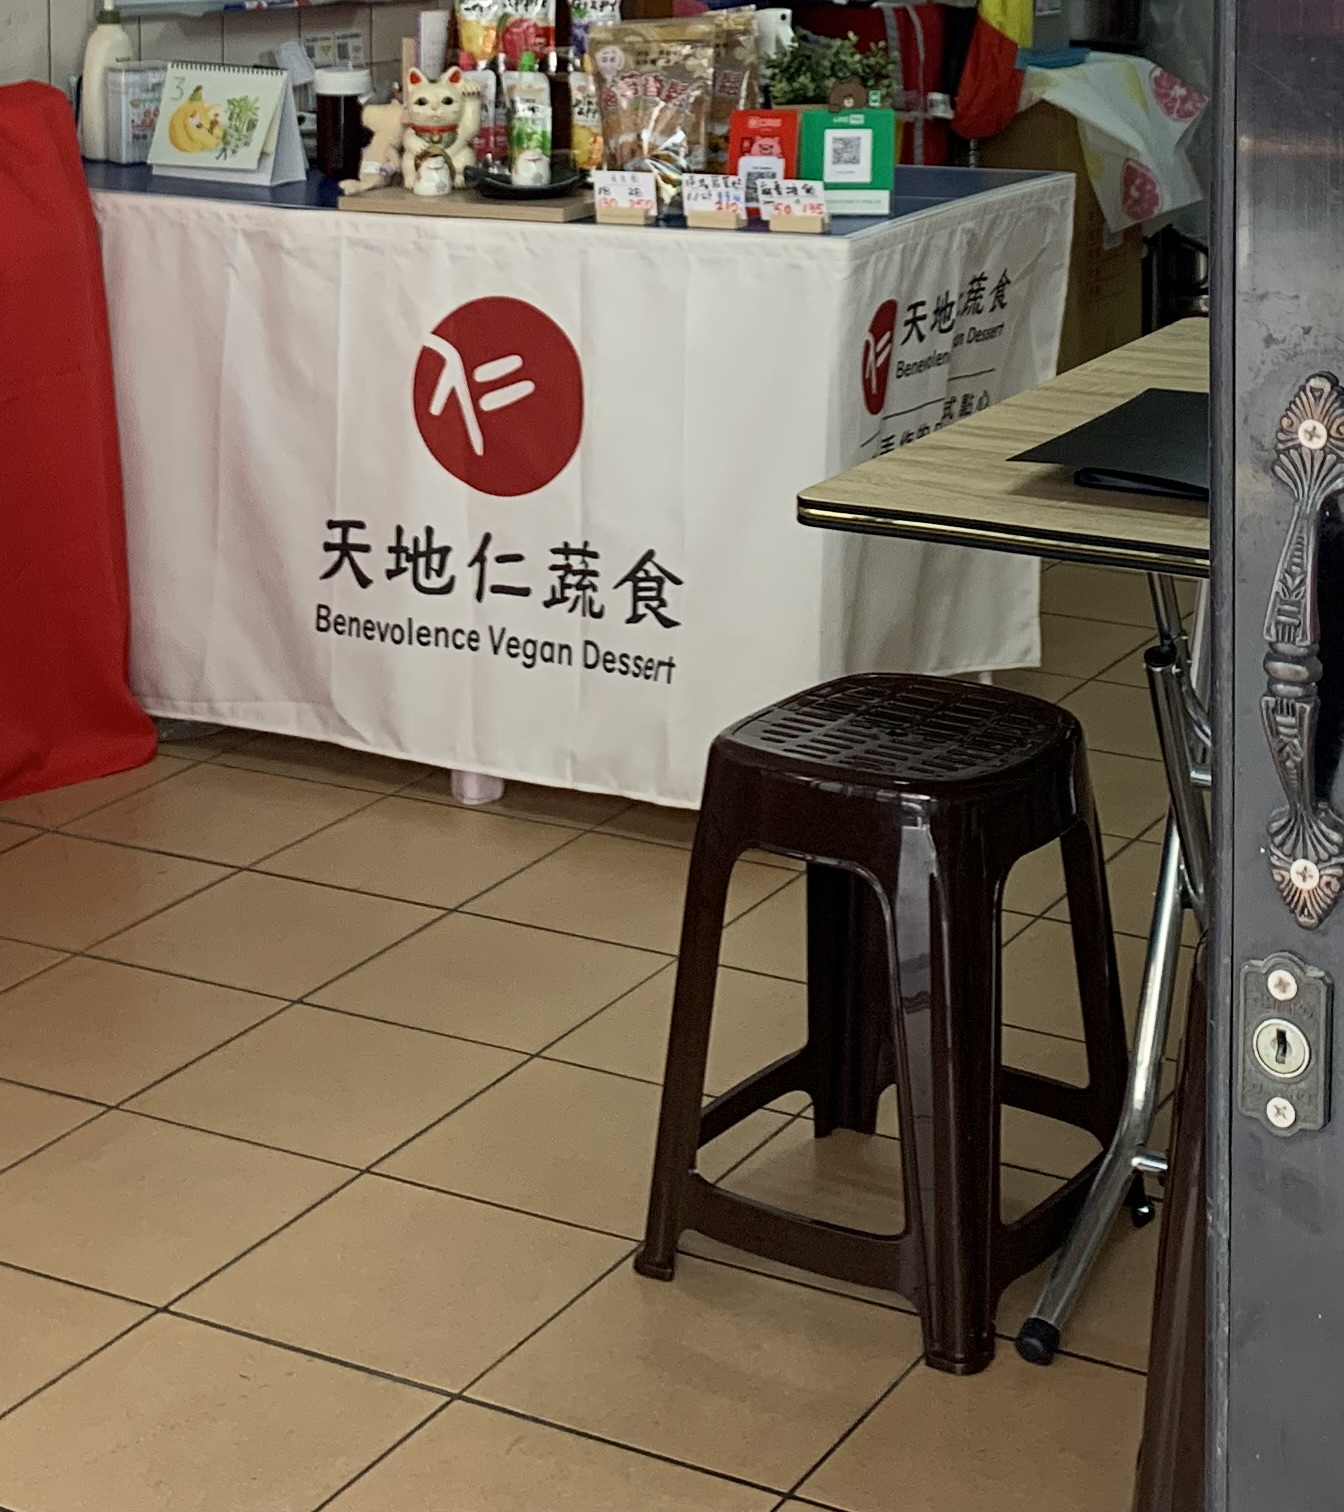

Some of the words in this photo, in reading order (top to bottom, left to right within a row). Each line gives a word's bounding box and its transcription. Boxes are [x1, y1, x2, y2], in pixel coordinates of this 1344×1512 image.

[900, 267, 1012, 346] 天地蔬食
[319, 518, 684, 630] 天地仁蔬食
[314, 603, 480, 654] Benevolence
[489, 626, 573, 668] Vegan
[582, 646, 676, 685] Dessert
